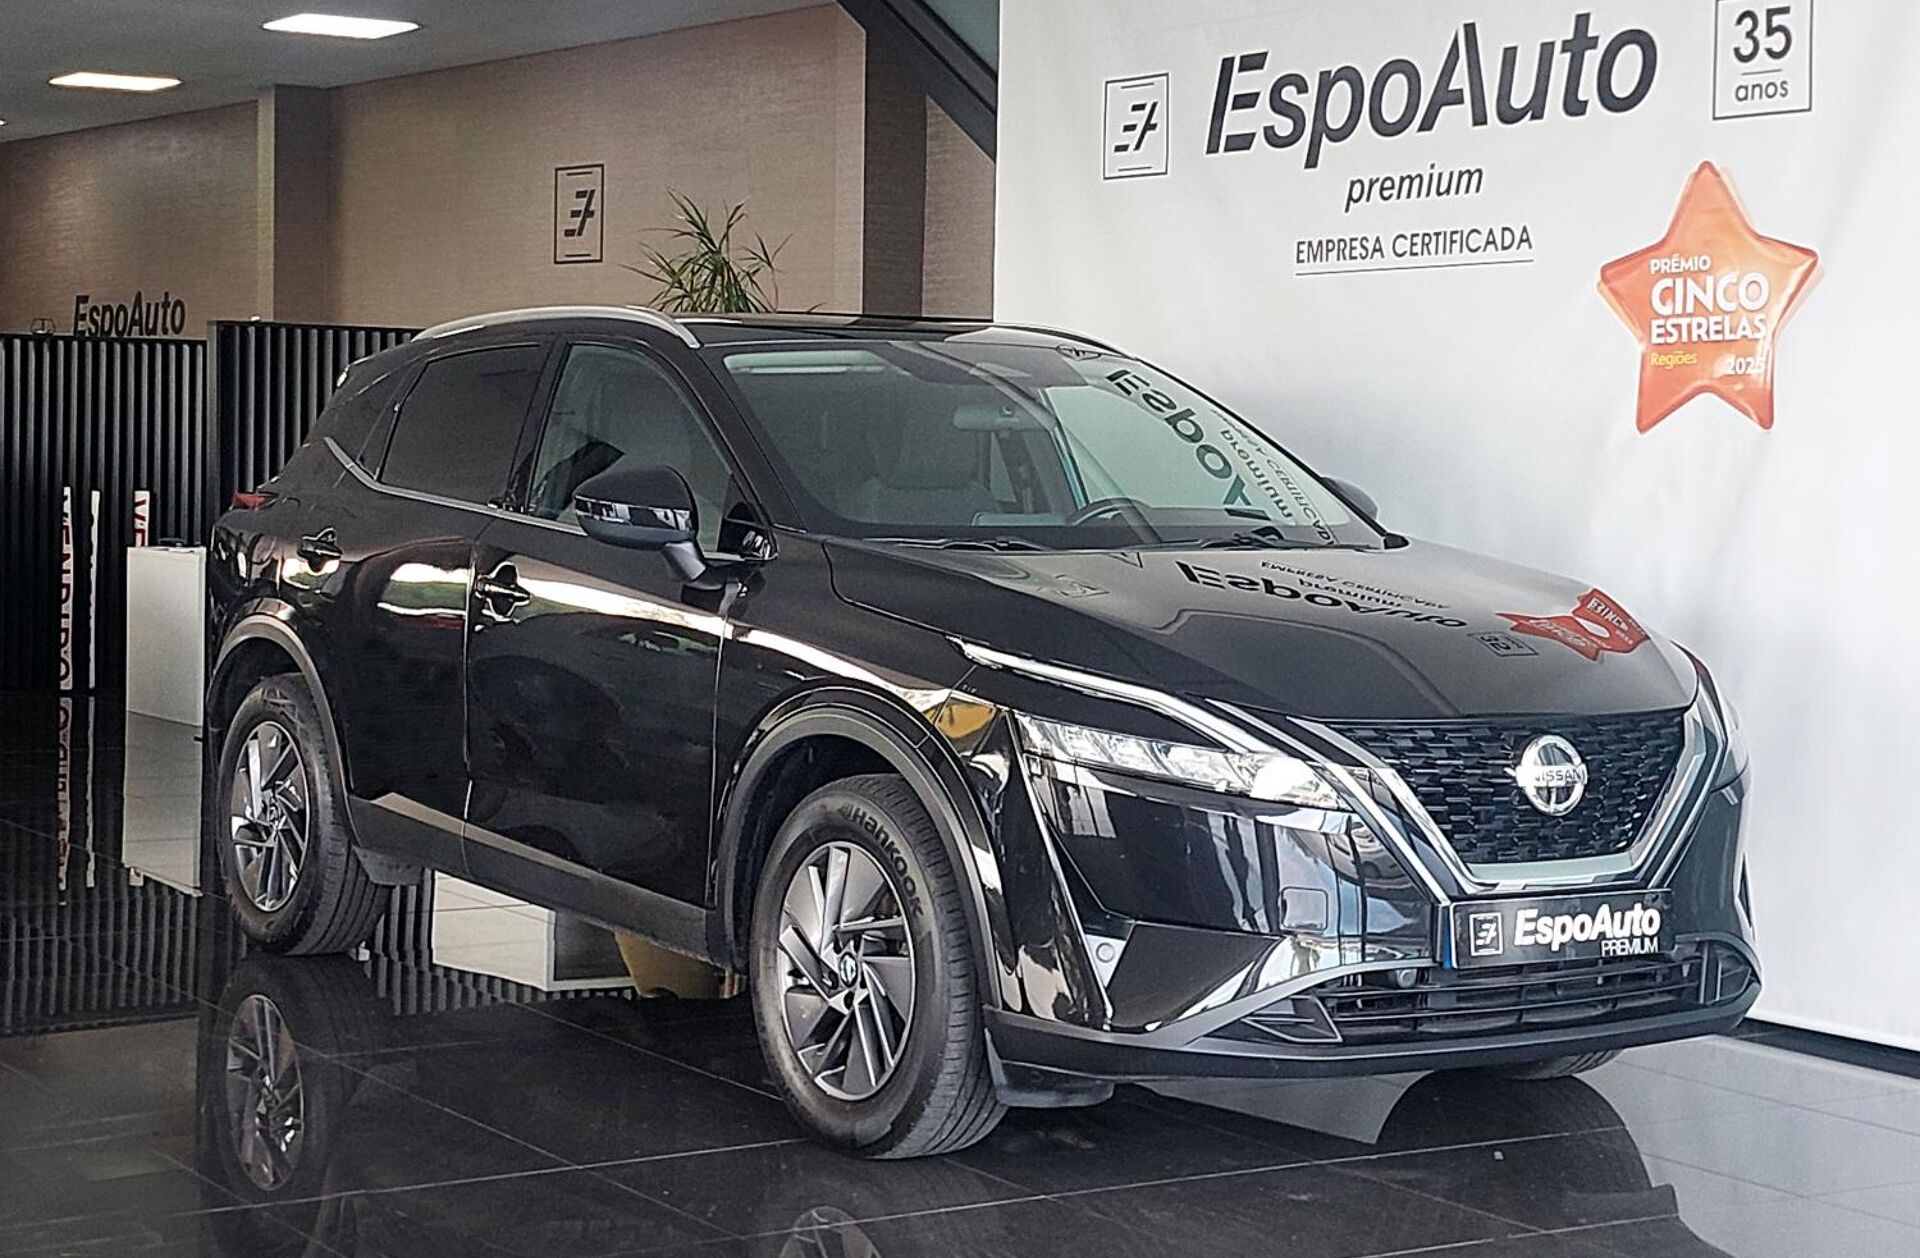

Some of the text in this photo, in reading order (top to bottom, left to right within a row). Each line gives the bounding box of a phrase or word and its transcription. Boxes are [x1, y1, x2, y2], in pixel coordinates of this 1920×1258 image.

[1732, 6, 1792, 64] 35
[1205, 12, 1658, 169] EspoAuto
[1735, 78, 1789, 102] anos
[1344, 163, 1483, 213] premium
[1296, 225, 1533, 264] EMPRESA CERTIFICADA
[1650, 253, 1711, 275] PRÉMIO
[1651, 271, 1770, 317] CINCO
[73, 290, 186, 338] EspoAuto
[1651, 314, 1767, 345] ESTRELAS
[1650, 350, 1698, 369] Regiões
[1530, 768, 1582, 783] ISSAN
[1513, 902, 1661, 952] EspoAuto
[1600, 936, 1660, 958] PREMIUM
